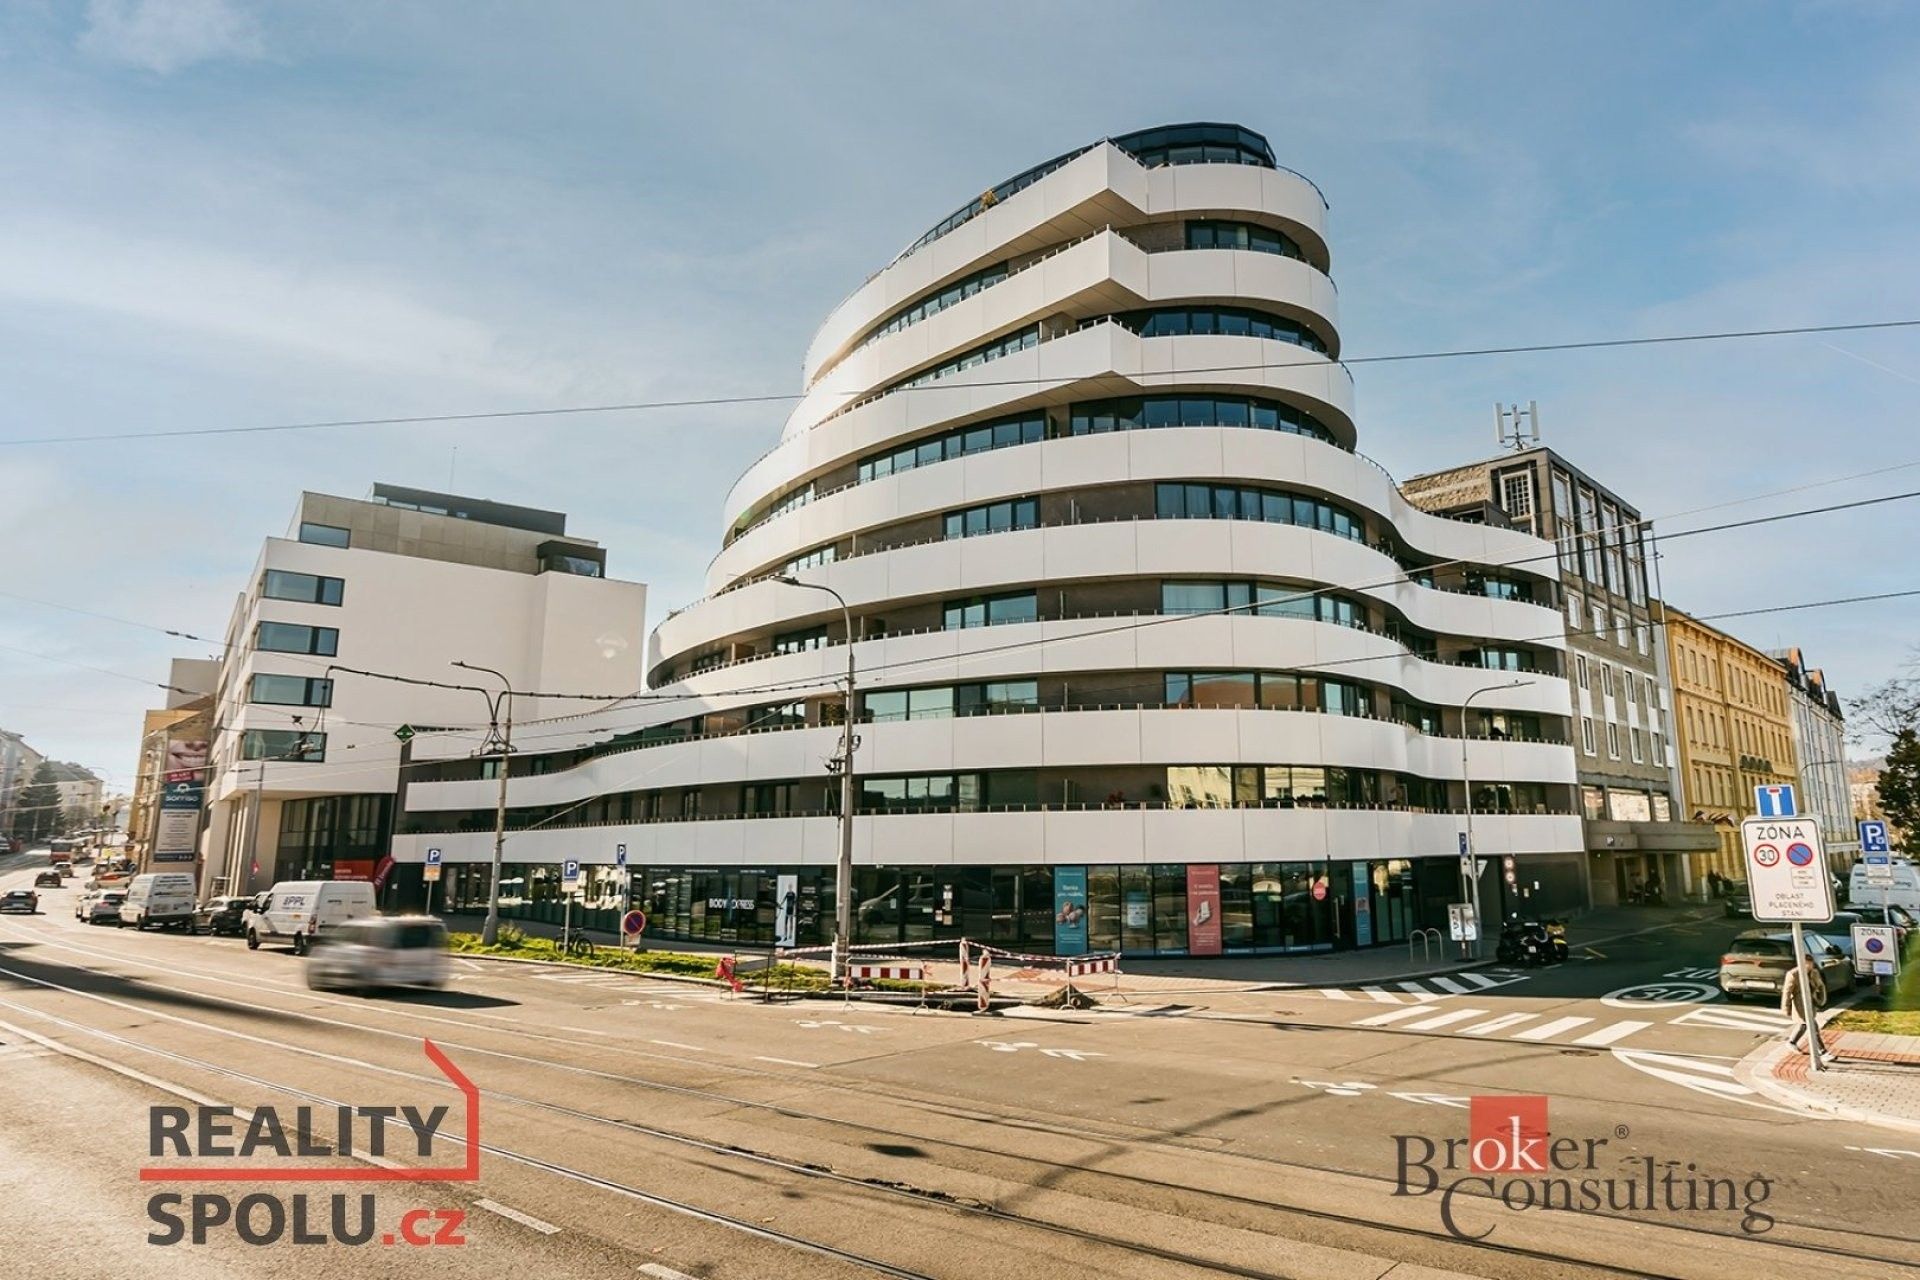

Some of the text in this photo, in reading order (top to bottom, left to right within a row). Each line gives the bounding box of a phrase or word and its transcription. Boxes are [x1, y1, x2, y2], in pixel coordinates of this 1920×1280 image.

[1866, 825, 1882, 844] P
[430, 850, 440, 861] P
[1759, 849, 1775, 861] 30
[566, 862, 577, 875] P
[1621, 987, 1700, 1001] 30
